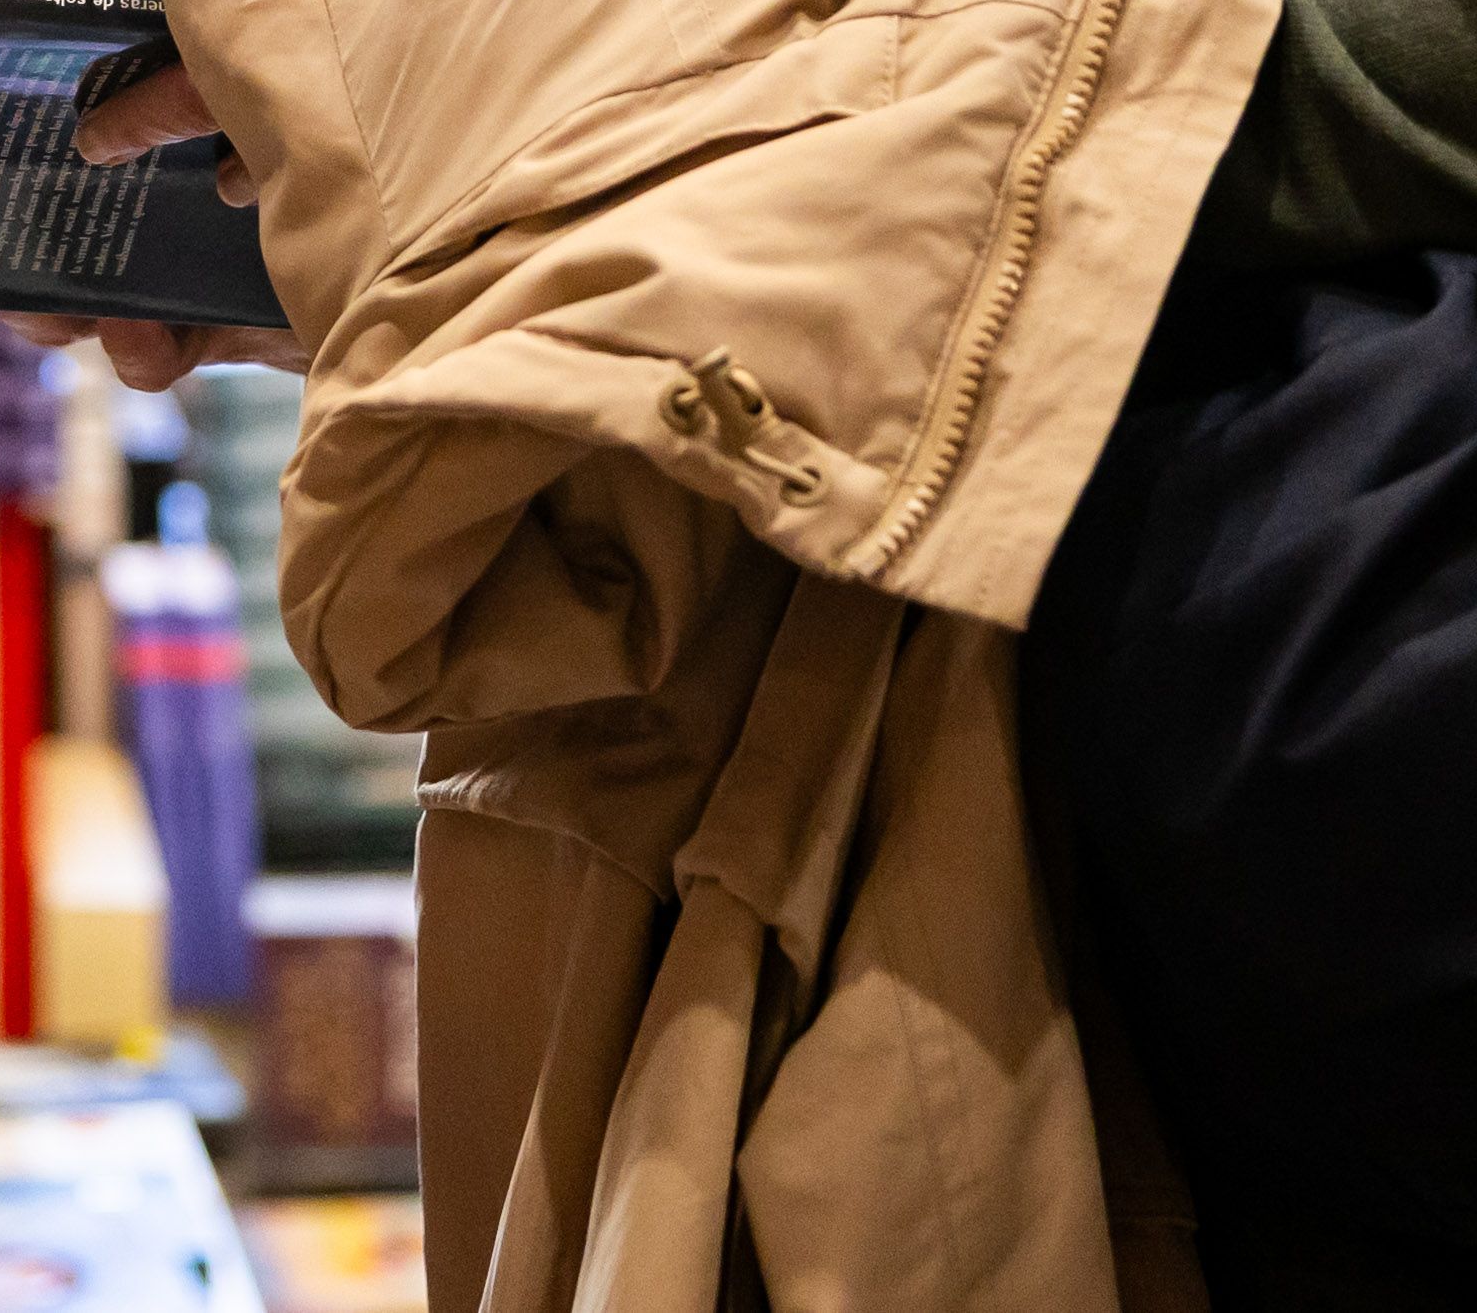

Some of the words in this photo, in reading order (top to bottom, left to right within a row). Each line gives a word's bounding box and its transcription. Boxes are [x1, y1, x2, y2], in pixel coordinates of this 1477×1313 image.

[0, 130, 16, 157] mirada
[15, 99, 28, 107] de
[48, 119, 64, 130] los
[45, 131, 60, 153] quien
[18, 148, 32, 170] gente
[8, 171, 25, 199] mucha
[31, 161, 51, 191] refugio
[54, 162, 72, 191] porque
[3, 201, 16, 220] para
[20, 193, 40, 224] ofrecen
[39, 194, 62, 229] historia,
[85, 177, 109, 217] distingue
[100, 211, 120, 238] Volver
[116, 180, 129, 201] estas
[132, 185, 149, 218] quienes
[63, 207, 78, 232] social,
[85, 218, 98, 235] que
[34, 230, 51, 259] propia
[75, 236, 91, 263] virtud
